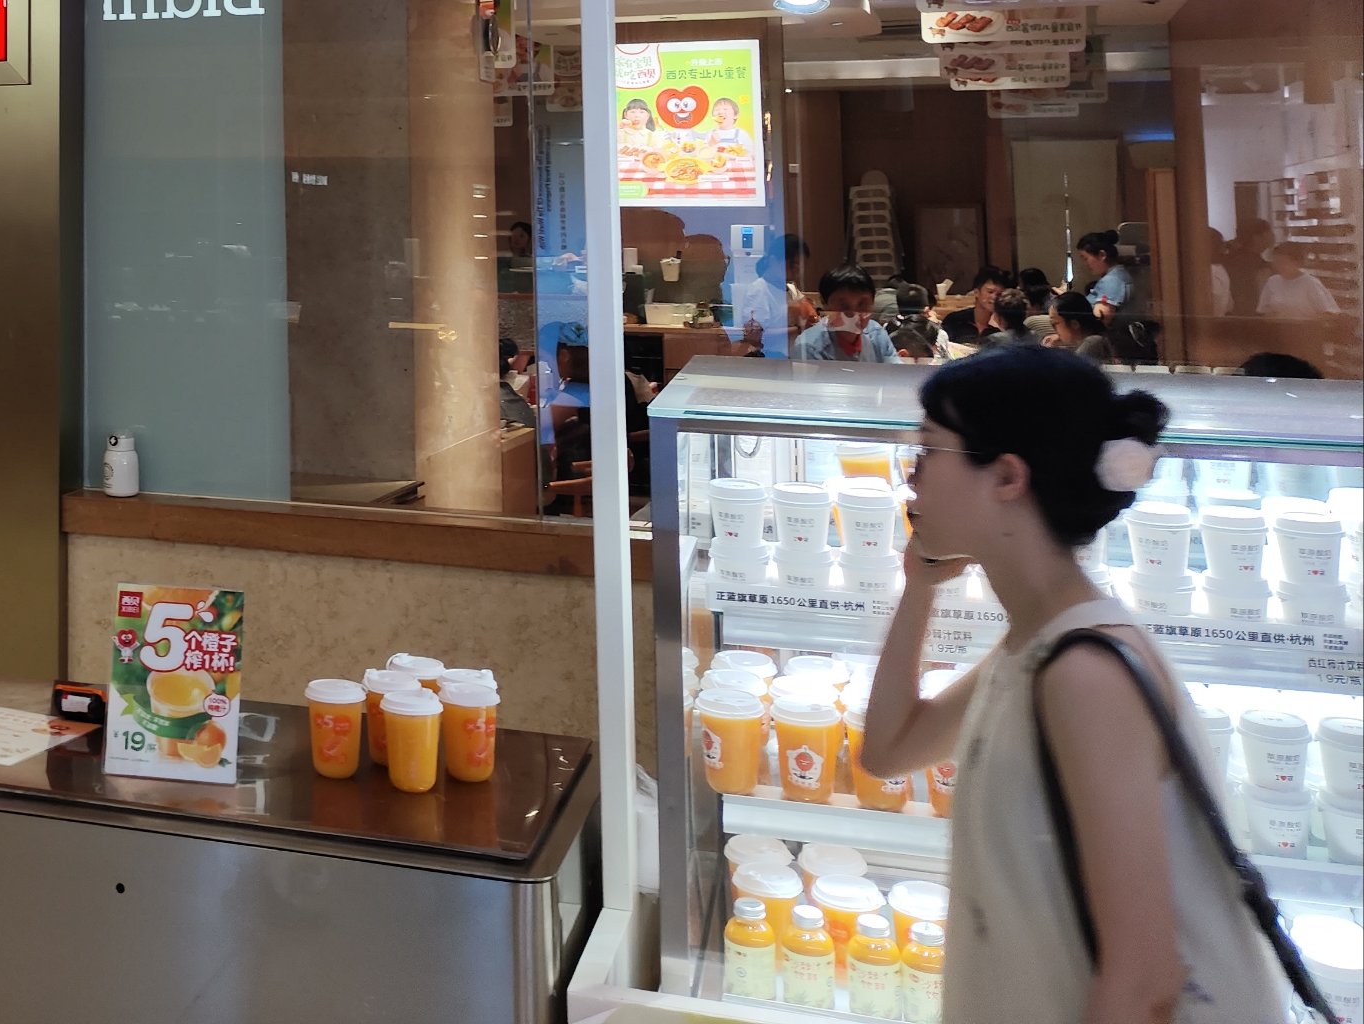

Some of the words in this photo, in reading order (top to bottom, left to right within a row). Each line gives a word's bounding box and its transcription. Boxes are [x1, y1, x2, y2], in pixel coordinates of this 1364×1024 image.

[666, 66, 747, 80] 西贝专业儿童餐
[140, 602, 195, 672] 5
[185, 631, 237, 652] 个橙子
